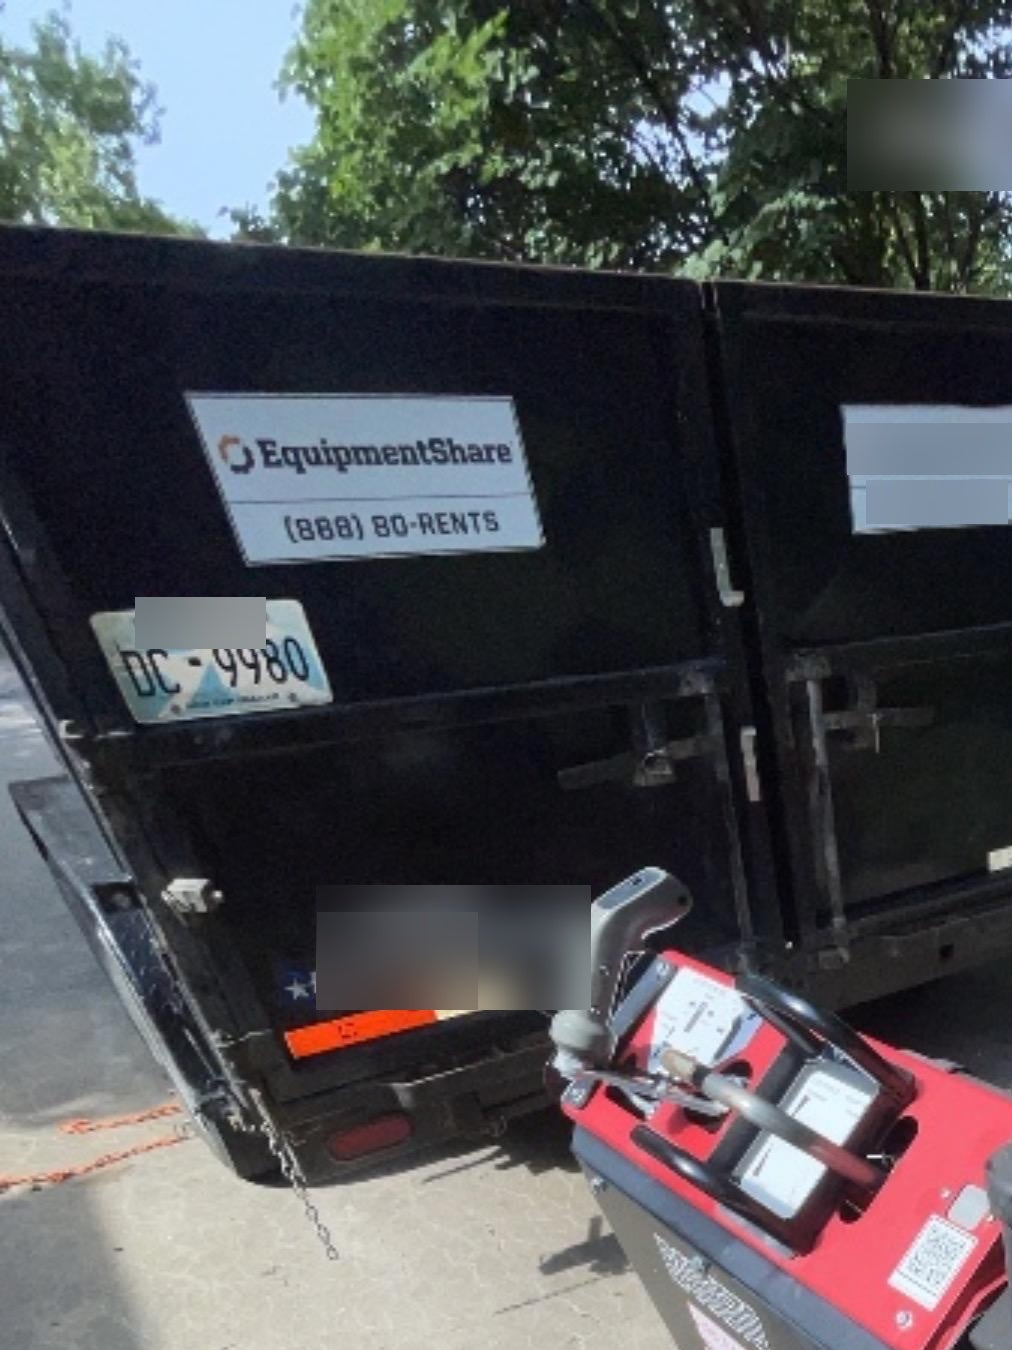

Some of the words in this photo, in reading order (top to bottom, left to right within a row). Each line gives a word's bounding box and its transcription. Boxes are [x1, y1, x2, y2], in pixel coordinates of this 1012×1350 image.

[257, 438, 513, 474] EquipmentShare
[284, 514, 363, 543] (888)
[371, 511, 499, 538] 80-RENTS
